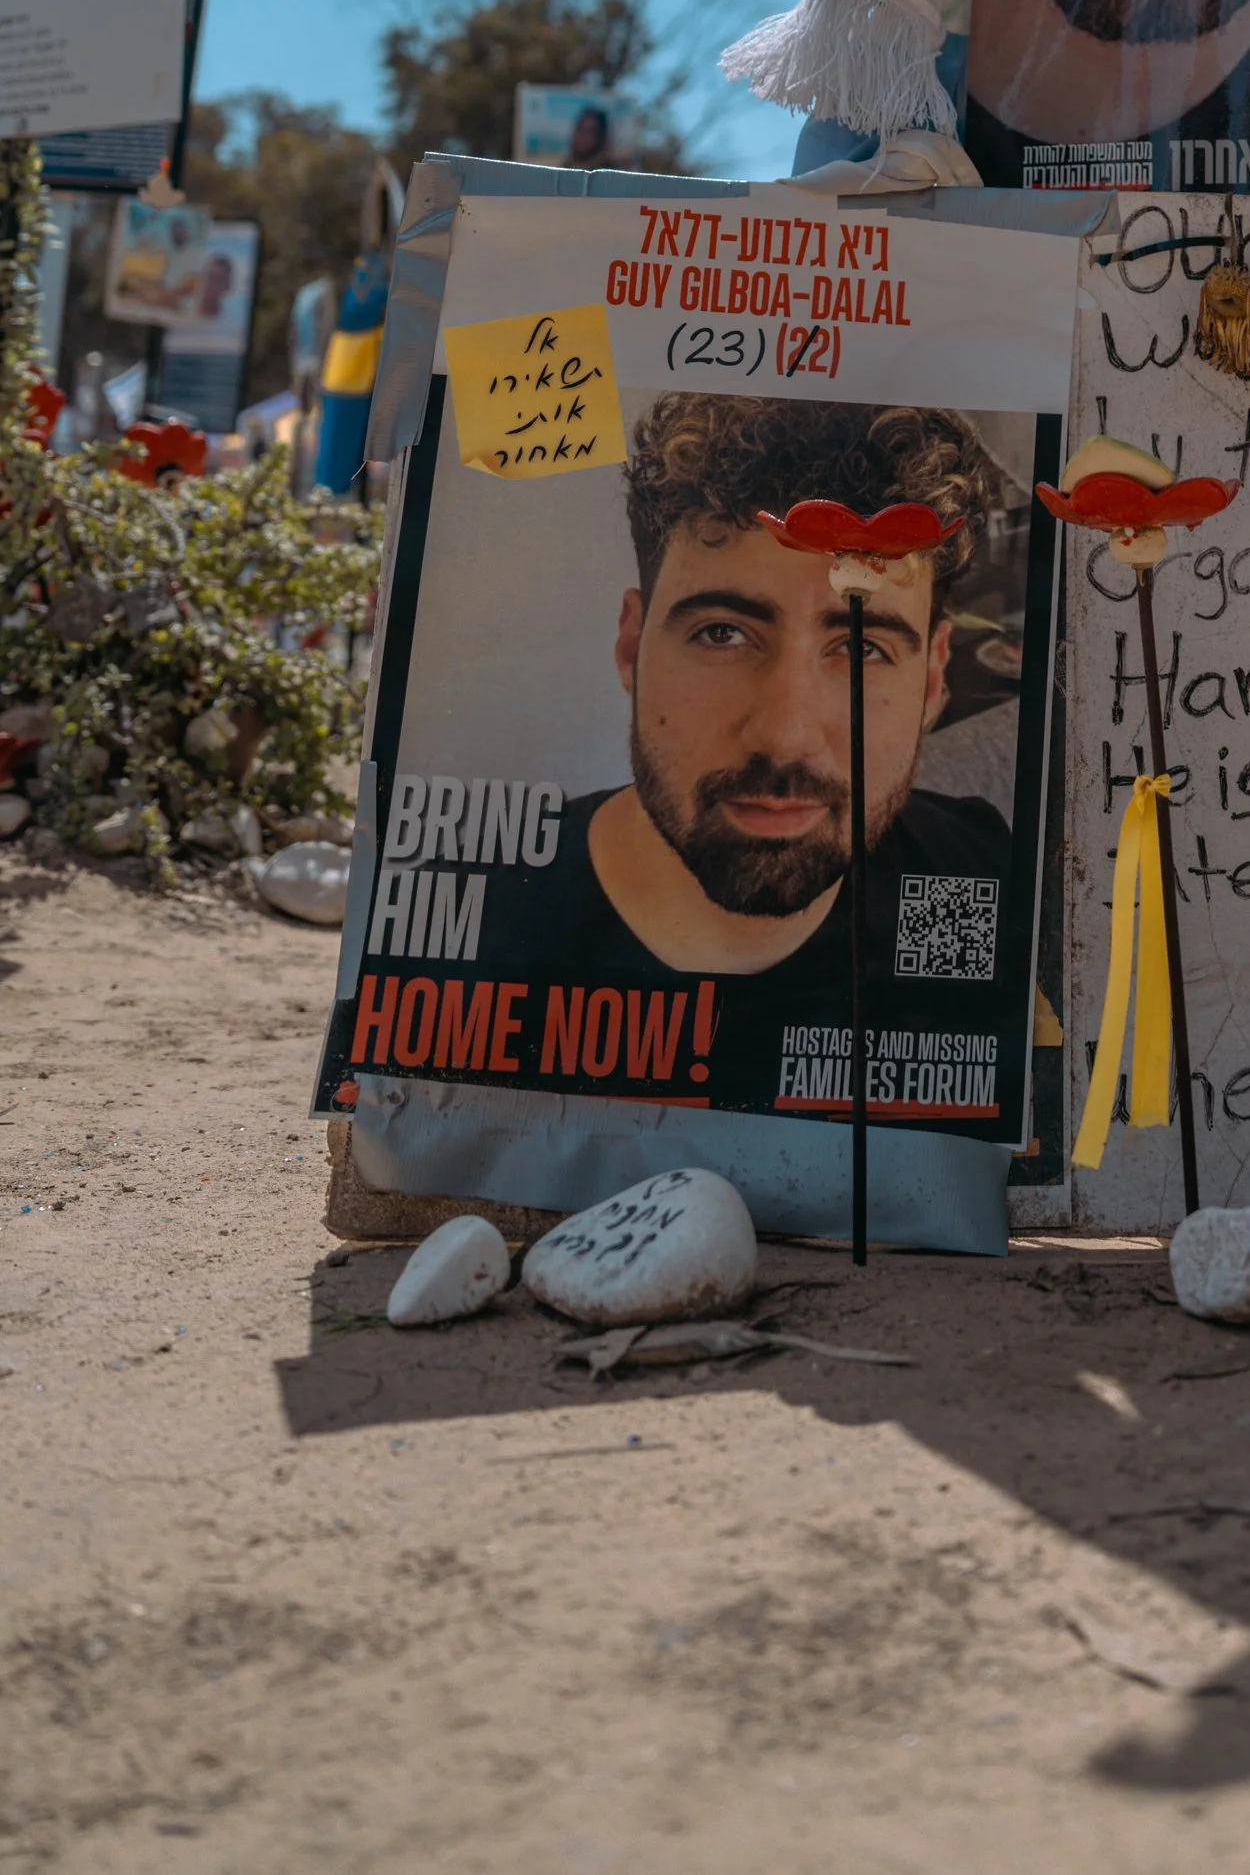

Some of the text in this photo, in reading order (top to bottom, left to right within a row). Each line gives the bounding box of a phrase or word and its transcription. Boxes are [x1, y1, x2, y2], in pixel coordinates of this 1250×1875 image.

[1022, 162, 1153, 190] החטופים והנעדרים
[1023, 140, 1153, 165] מטה המשפחות להחזרת
[638, 205, 889, 272] גיא גלבוע-דלאל
[604, 259, 911, 327] GUY GILBOA-DALAL
[523, 316, 560, 355] אל
[666, 322, 766, 377] (23)
[775, 322, 842, 379] (22)
[503, 394, 587, 436] אותי
[493, 435, 598, 470] מאחור
[382, 772, 564, 869] BRING
[366, 869, 489, 963] HIM
[349, 974, 716, 1085] HOME NOW!
[781, 1025, 998, 1064] HOSTAGS AND MISSING
[778, 1056, 997, 1108] FAMILES FORUM
